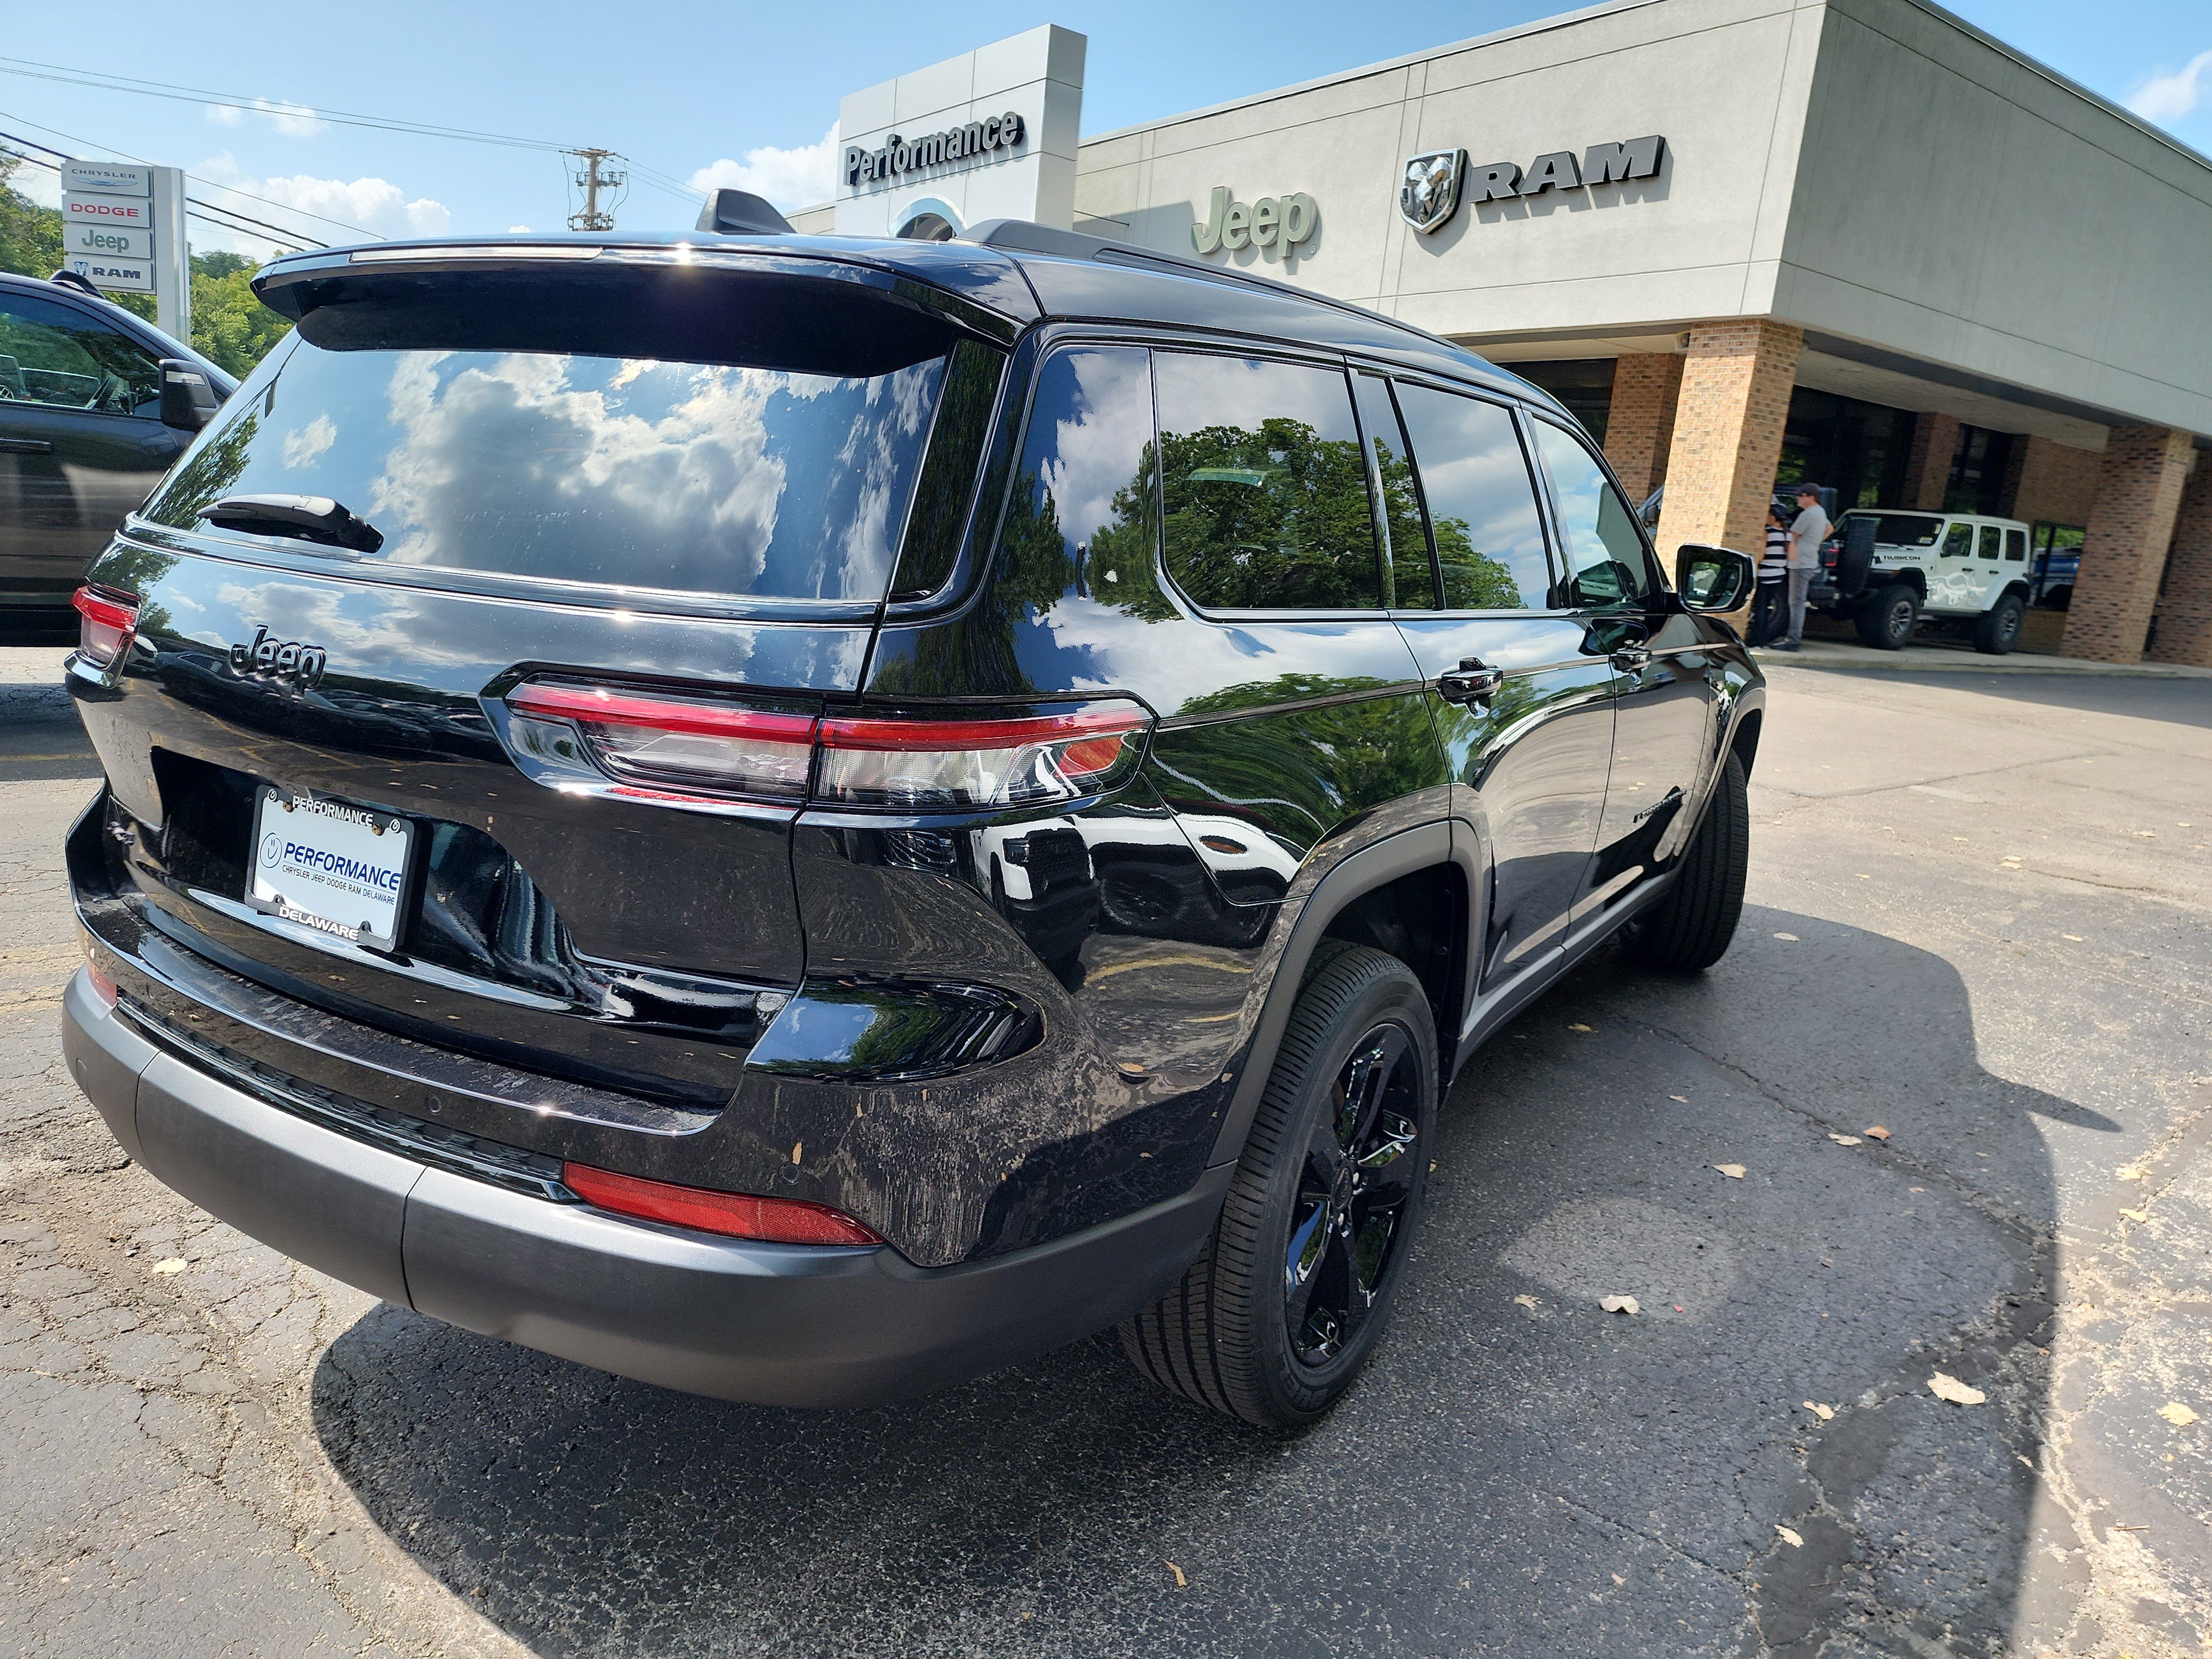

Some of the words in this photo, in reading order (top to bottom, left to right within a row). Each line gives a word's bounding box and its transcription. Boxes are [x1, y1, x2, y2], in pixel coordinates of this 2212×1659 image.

[843, 111, 1025, 185] Performance
[71, 169, 136, 179] CHRYSLER
[1466, 134, 1666, 204] RAM
[71, 203, 139, 217] DODGE
[1192, 186, 1318, 258] Jeep
[81, 229, 129, 253] Jeep
[92, 267, 141, 279] RAM
[229, 623, 327, 700] Jeep
[292, 795, 374, 827] PERFORMANCE
[282, 864, 310, 880] CHRYSLER
[311, 873, 326, 884] JEEP
[327, 878, 347, 890] DODGE
[348, 884, 361, 895] RAM
[363, 888, 395, 906] DELAWARE
[284, 842, 402, 891] PERFORMANCE
[279, 906, 359, 941] DELAWARE
